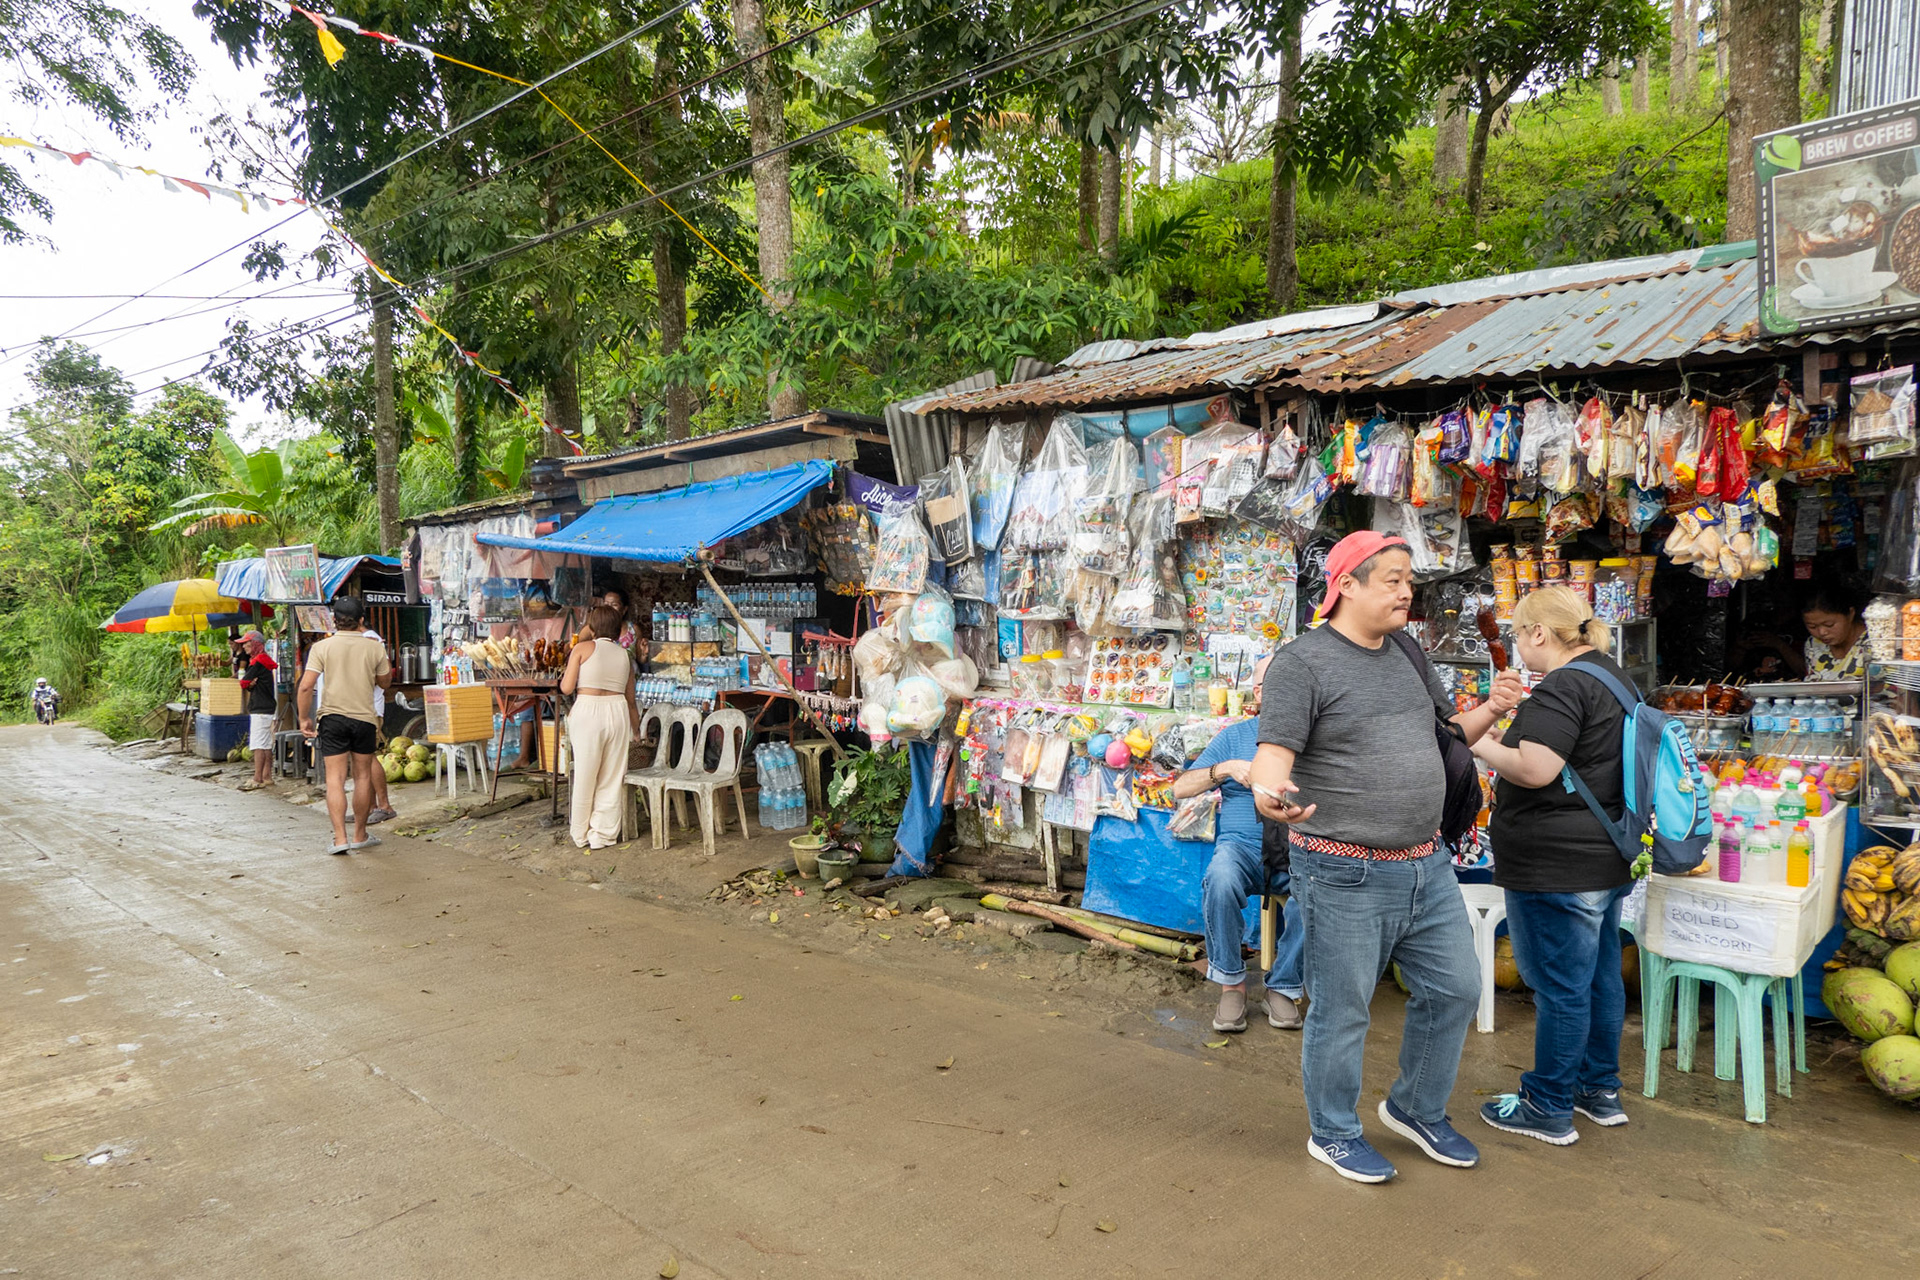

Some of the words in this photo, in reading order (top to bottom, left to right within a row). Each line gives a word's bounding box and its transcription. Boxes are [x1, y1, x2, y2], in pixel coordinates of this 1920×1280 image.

[1805, 137, 1848, 161] BREW
[1853, 121, 1913, 149] COFFEE
[861, 483, 893, 506] Aice
[366, 594, 401, 603] SIRAO
[1671, 908, 1739, 930] BOILED
